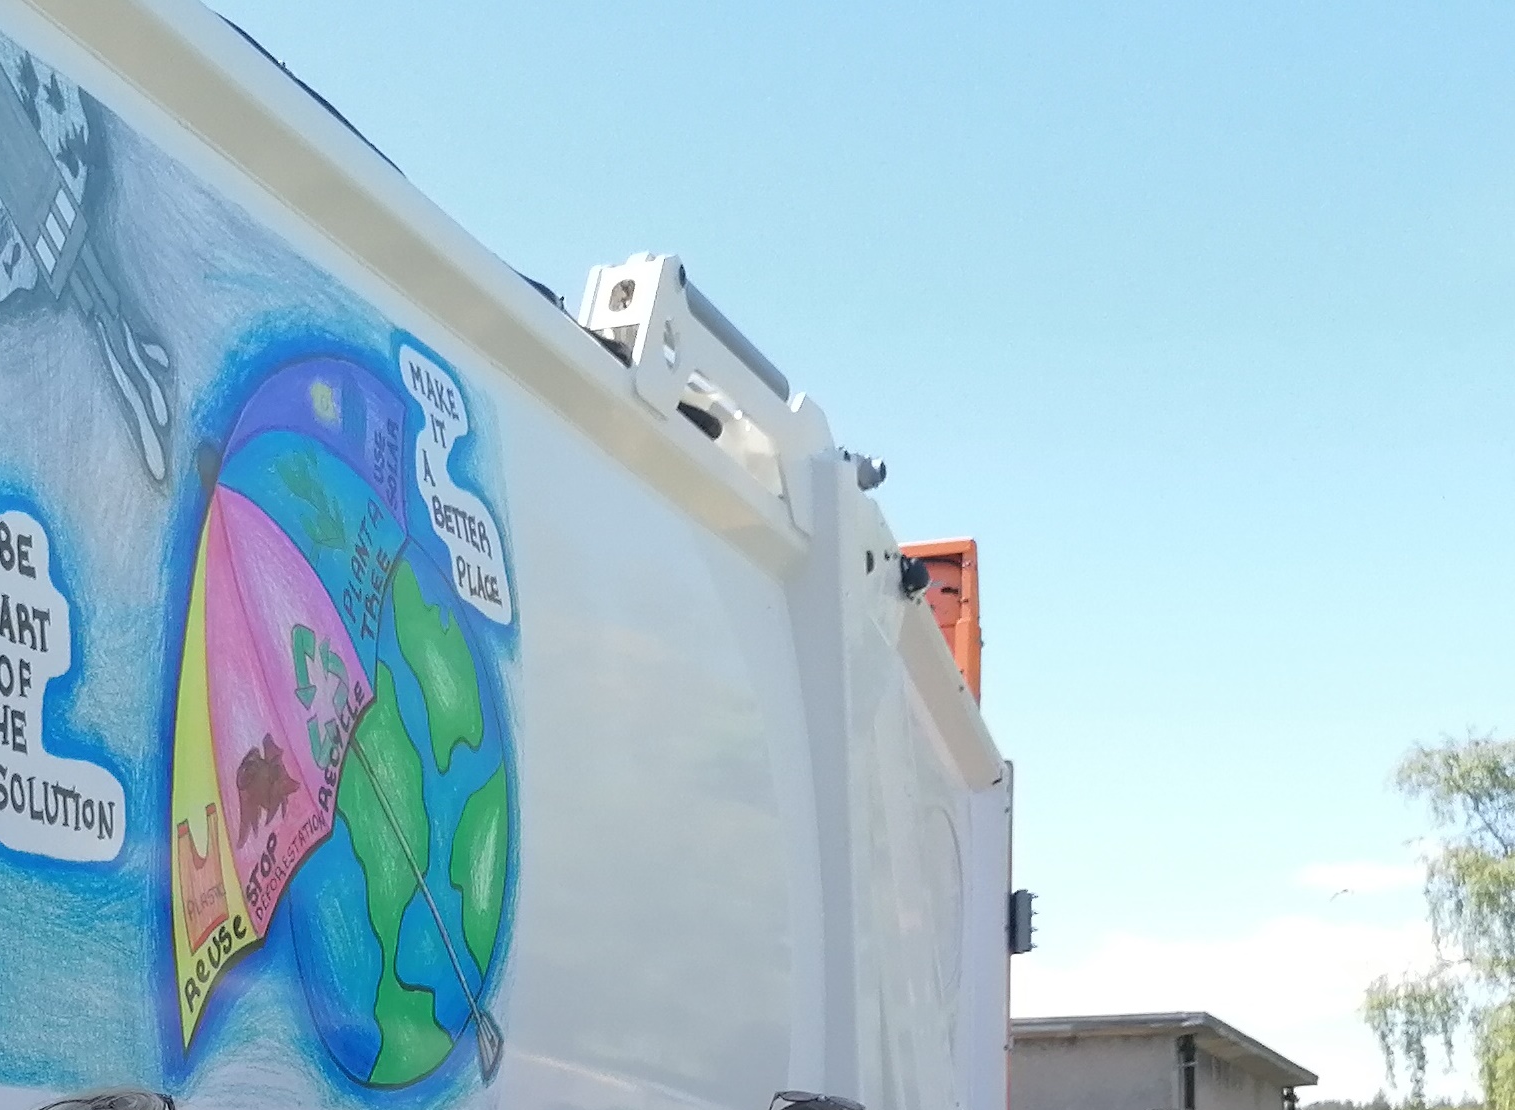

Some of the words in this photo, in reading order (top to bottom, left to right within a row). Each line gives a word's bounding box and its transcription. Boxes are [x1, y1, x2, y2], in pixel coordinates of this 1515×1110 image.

[408, 361, 460, 421] MAKE
[430, 413, 447, 449] IT
[422, 449, 436, 487] A
[431, 495, 493, 560] BETTER
[342, 515, 374, 624] PLANT
[361, 546, 391, 643] TREE
[456, 555, 503, 607] PLACE
[318, 680, 365, 813] RECYCLE
[246, 832, 277, 907] STOP
[255, 809, 326, 921] DEFORESTATION
